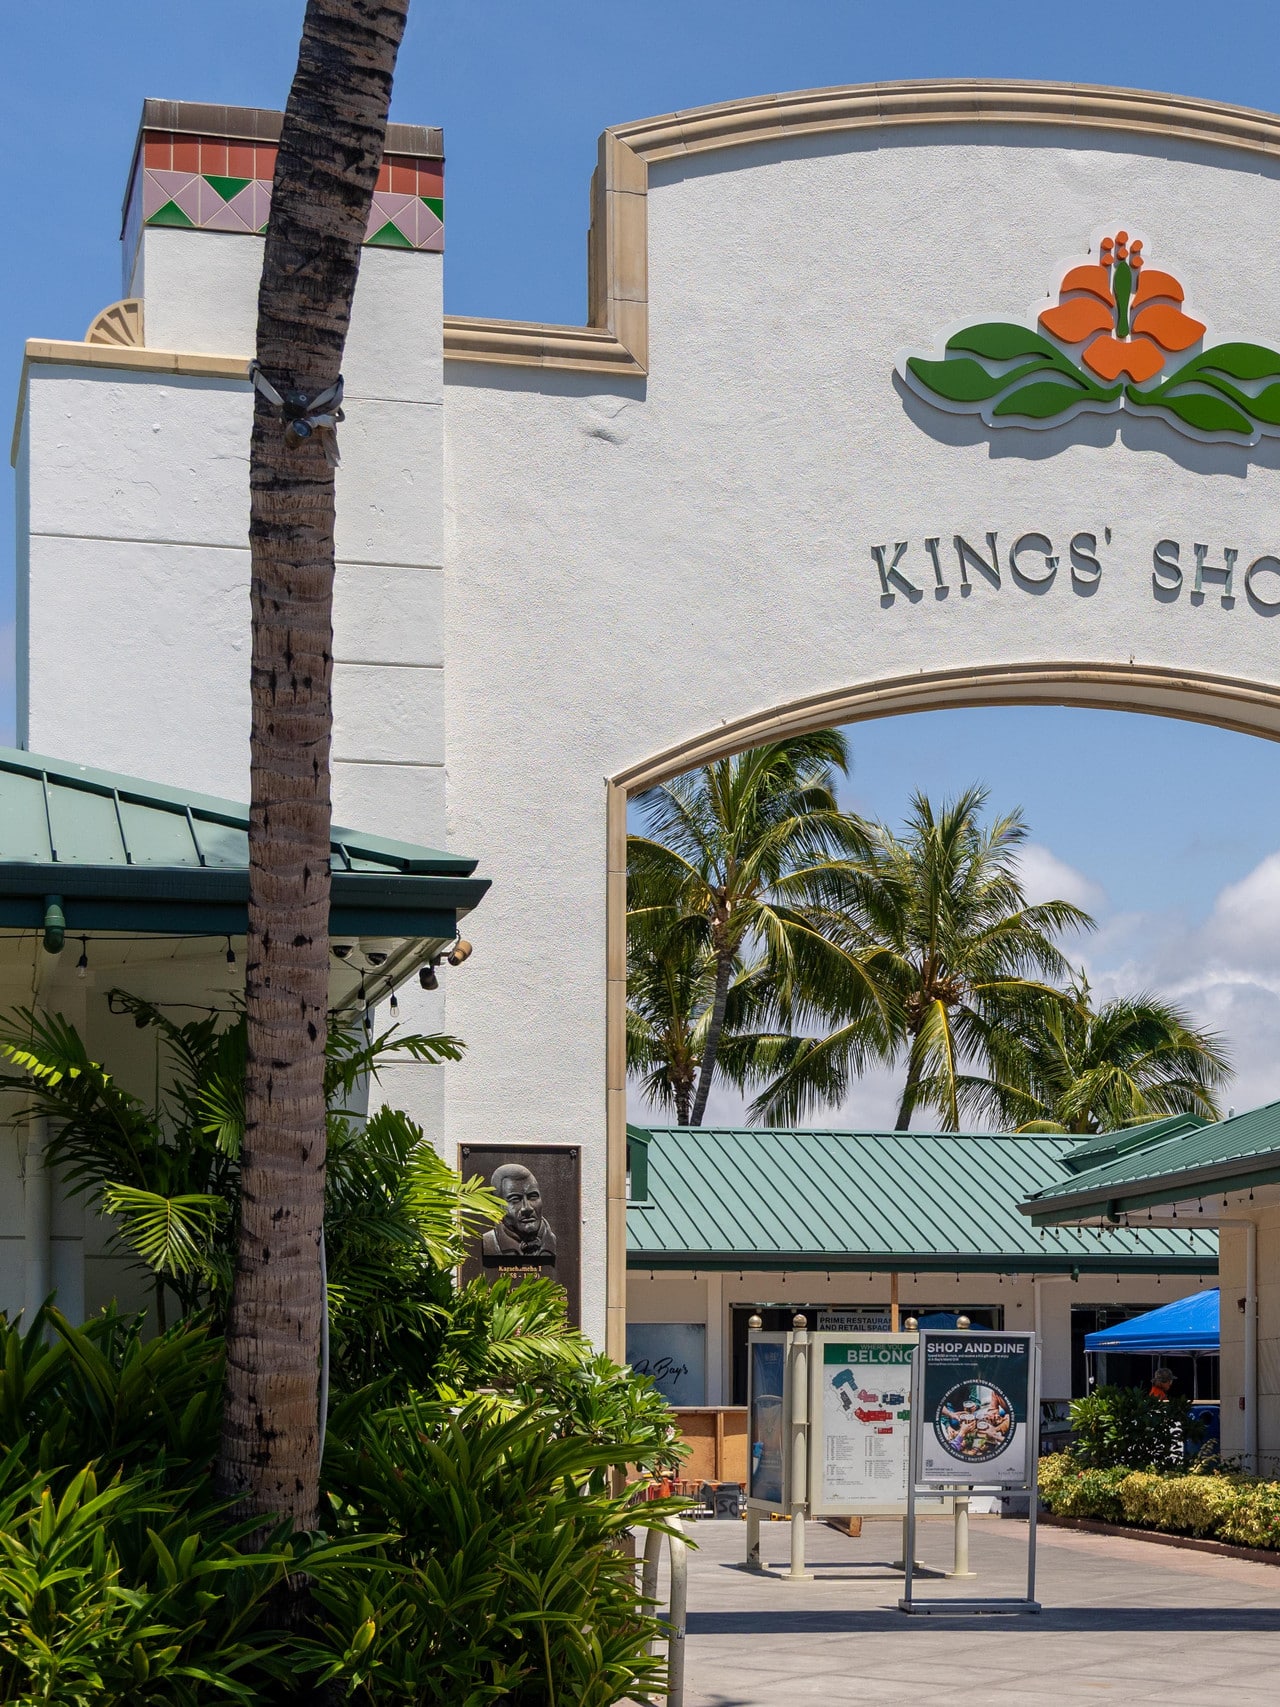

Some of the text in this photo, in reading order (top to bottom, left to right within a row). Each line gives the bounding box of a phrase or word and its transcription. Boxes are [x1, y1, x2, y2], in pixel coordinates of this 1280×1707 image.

[870, 525, 1112, 596] KINGS'
[927, 1343, 1025, 1354] SHOP AND DINE
